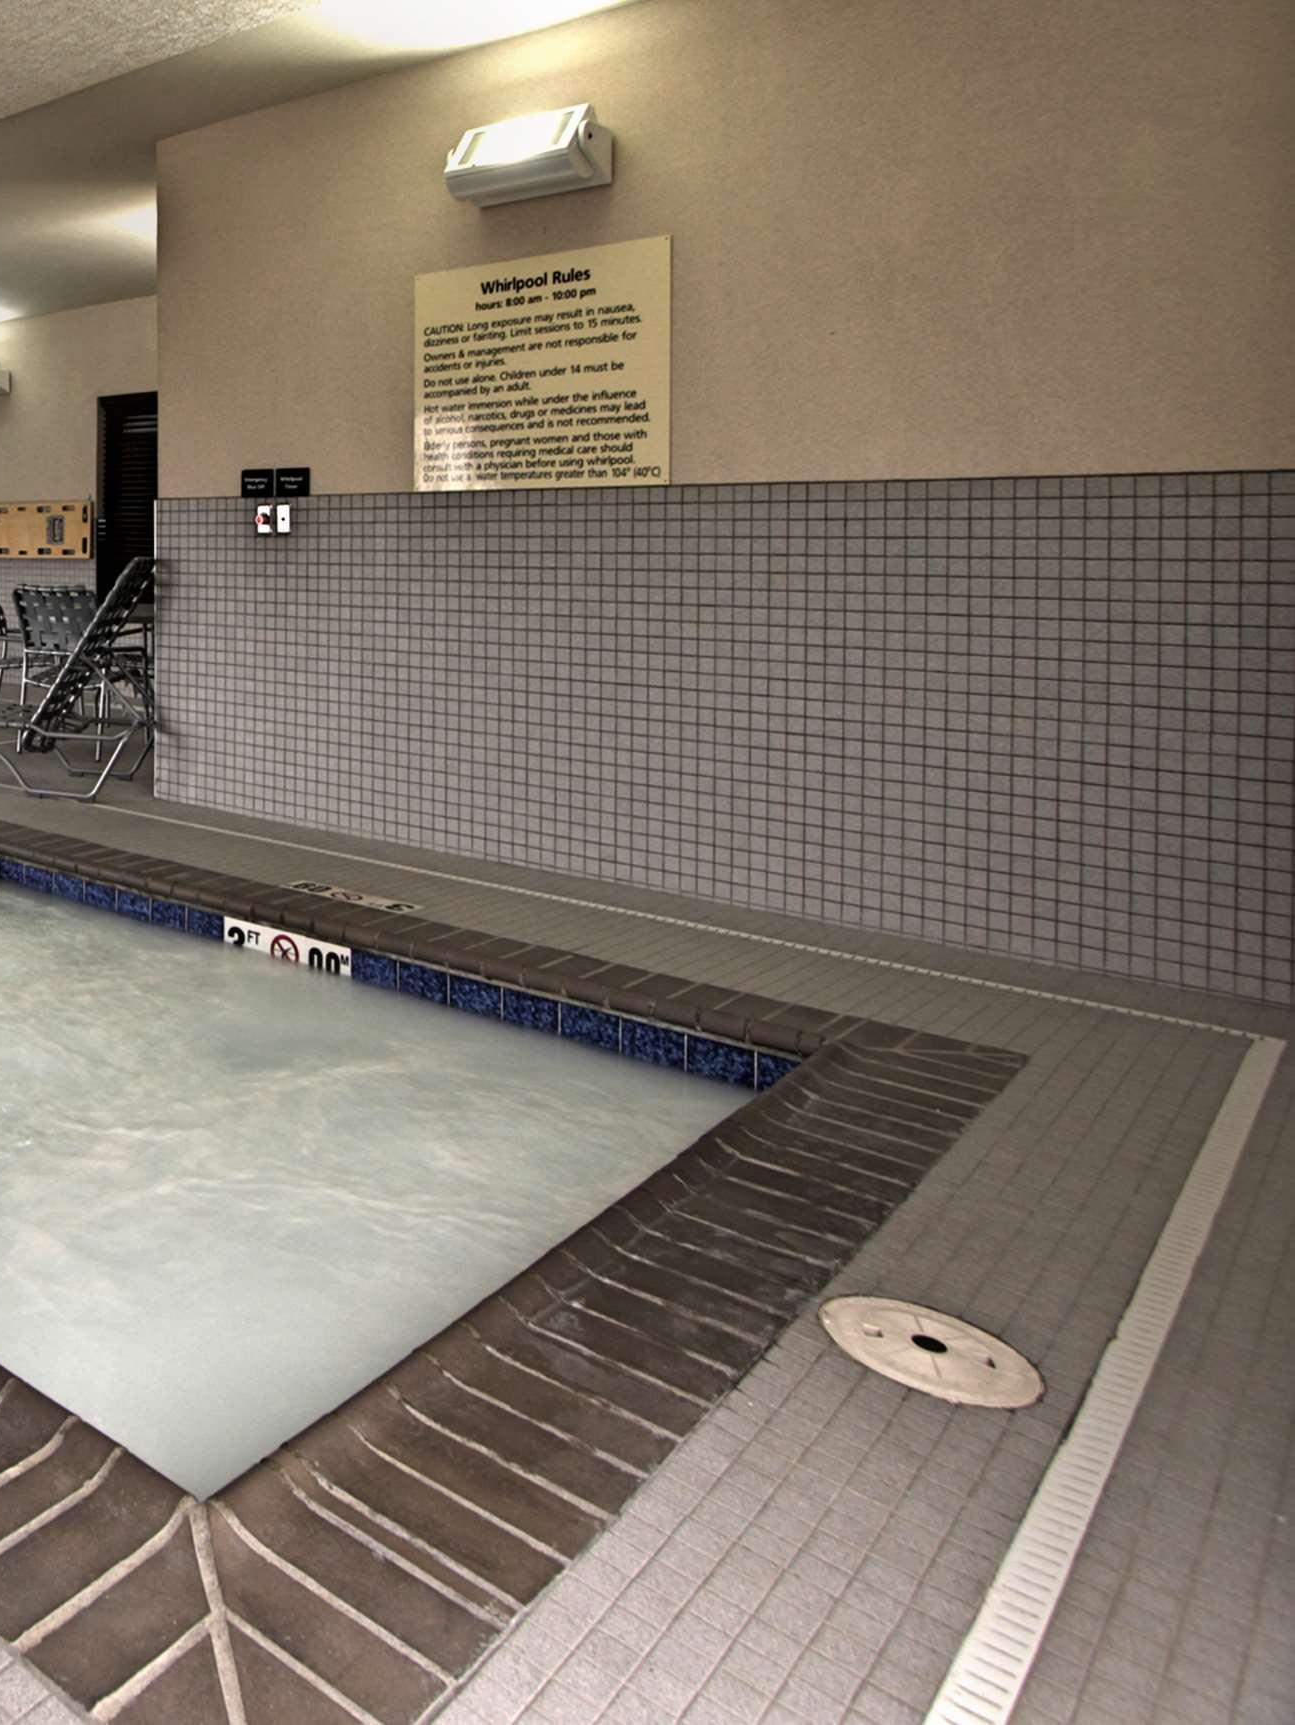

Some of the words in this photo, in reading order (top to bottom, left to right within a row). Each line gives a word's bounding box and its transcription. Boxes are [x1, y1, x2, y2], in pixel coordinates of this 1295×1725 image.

[481, 272, 547, 294] Whirlpool
[553, 268, 590, 284] Rules
[506, 296, 525, 307] 8:00
[528, 295, 542, 304] am
[552, 289, 576, 300] 10:00
[580, 288, 596, 299] pm
[467, 319, 488, 331] Long
[491, 315, 532, 328] exposure
[534, 313, 554, 323] may
[557, 309, 582, 319] result
[586, 307, 594, 316] in
[424, 336, 458, 347] dizziness
[510, 327, 531, 337] Limit
[534, 323, 570, 334] sessions
[573, 320, 584, 329] to
[588, 318, 597, 328] 15
[424, 352, 455, 362] Owners
[458, 349, 465, 358] &
[467, 343, 525, 356] management
[528, 341, 542, 351] are
[545, 339, 561, 348] not
[565, 332, 618, 348] responsible
[621, 330, 637, 340] for
[424, 361, 461, 373] accidents
[463, 361, 472, 369] or
[424, 379, 435, 388] Do
[438, 377, 452, 386] not
[455, 377, 469, 385] use
[500, 369, 536, 380] Children
[539, 366, 566, 376] under
[570, 364, 580, 374] 14
[583, 362, 608, 373] must
[611, 360, 624, 370] be
[424, 386, 477, 399] accompanied
[480, 385, 490, 396] by
[493, 384, 504, 393] an
[424, 403, 439, 414] Hot
[442, 403, 465, 412] water
[468, 399, 512, 410] immersion
[515, 396, 538, 406] while
[542, 394, 569, 403] under
[573, 392, 588, 402] the
[592, 389, 637, 400] influence
[424, 416, 432, 425] of
[510, 409, 535, 419] drugs
[538, 408, 547, 416] or
[551, 404, 597, 415] medicines
[600, 403, 621, 413] may
[624, 400, 646, 411] lead
[424, 427, 433, 436] to
[466, 422, 524, 434] consequences
[527, 420, 544, 429] and
[547, 419, 554, 428] is
[557, 417, 573, 427] not
[490, 437, 531, 449] pregnant
[533, 435, 569, 444] women
[572, 431, 591, 441] and
[594, 431, 621, 441] those
[624, 428, 647, 439] with
[452, 449, 493, 459] conditions
[497, 447, 536, 458] requiring
[539, 444, 574, 456] medical
[577, 445, 597, 455] care
[600, 441, 633, 453] should
[423, 474, 434, 482] Do
[436, 473, 448, 481] not
[476, 472, 497, 480] water
[500, 470, 552, 481] temperatures
[555, 469, 585, 480] greater
[588, 467, 607, 478] than
[484, 460, 522, 471] physician
[525, 457, 556, 468] before
[559, 457, 584, 469] using
